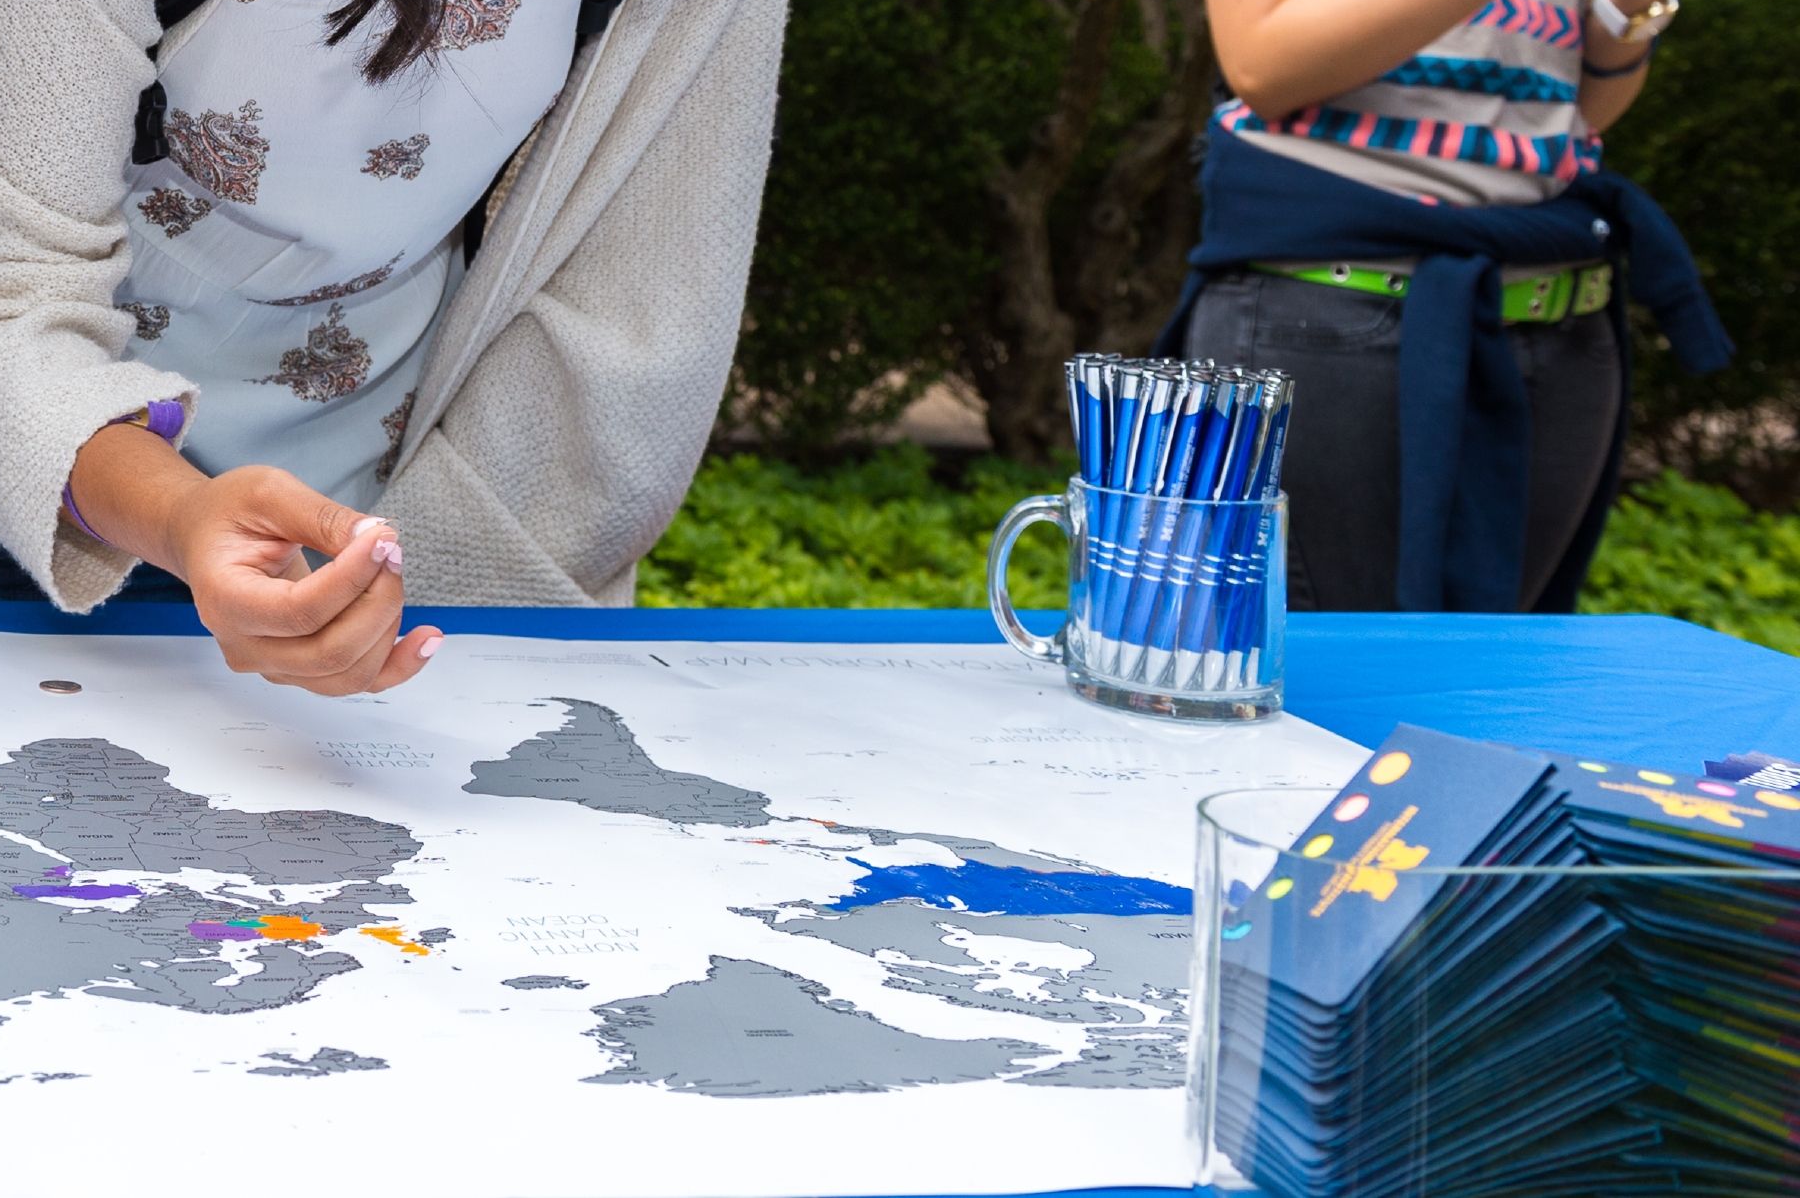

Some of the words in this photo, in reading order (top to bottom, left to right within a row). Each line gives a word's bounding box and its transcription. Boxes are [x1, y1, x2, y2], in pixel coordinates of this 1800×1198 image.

[327, 742, 411, 750] OCEAN
[318, 750, 435, 759] ATLANTIC
[344, 760, 430, 768] SOUTH
[506, 914, 609, 927] OCEAN
[499, 927, 639, 942] ATLANTIC
[530, 942, 640, 955] NORTH
